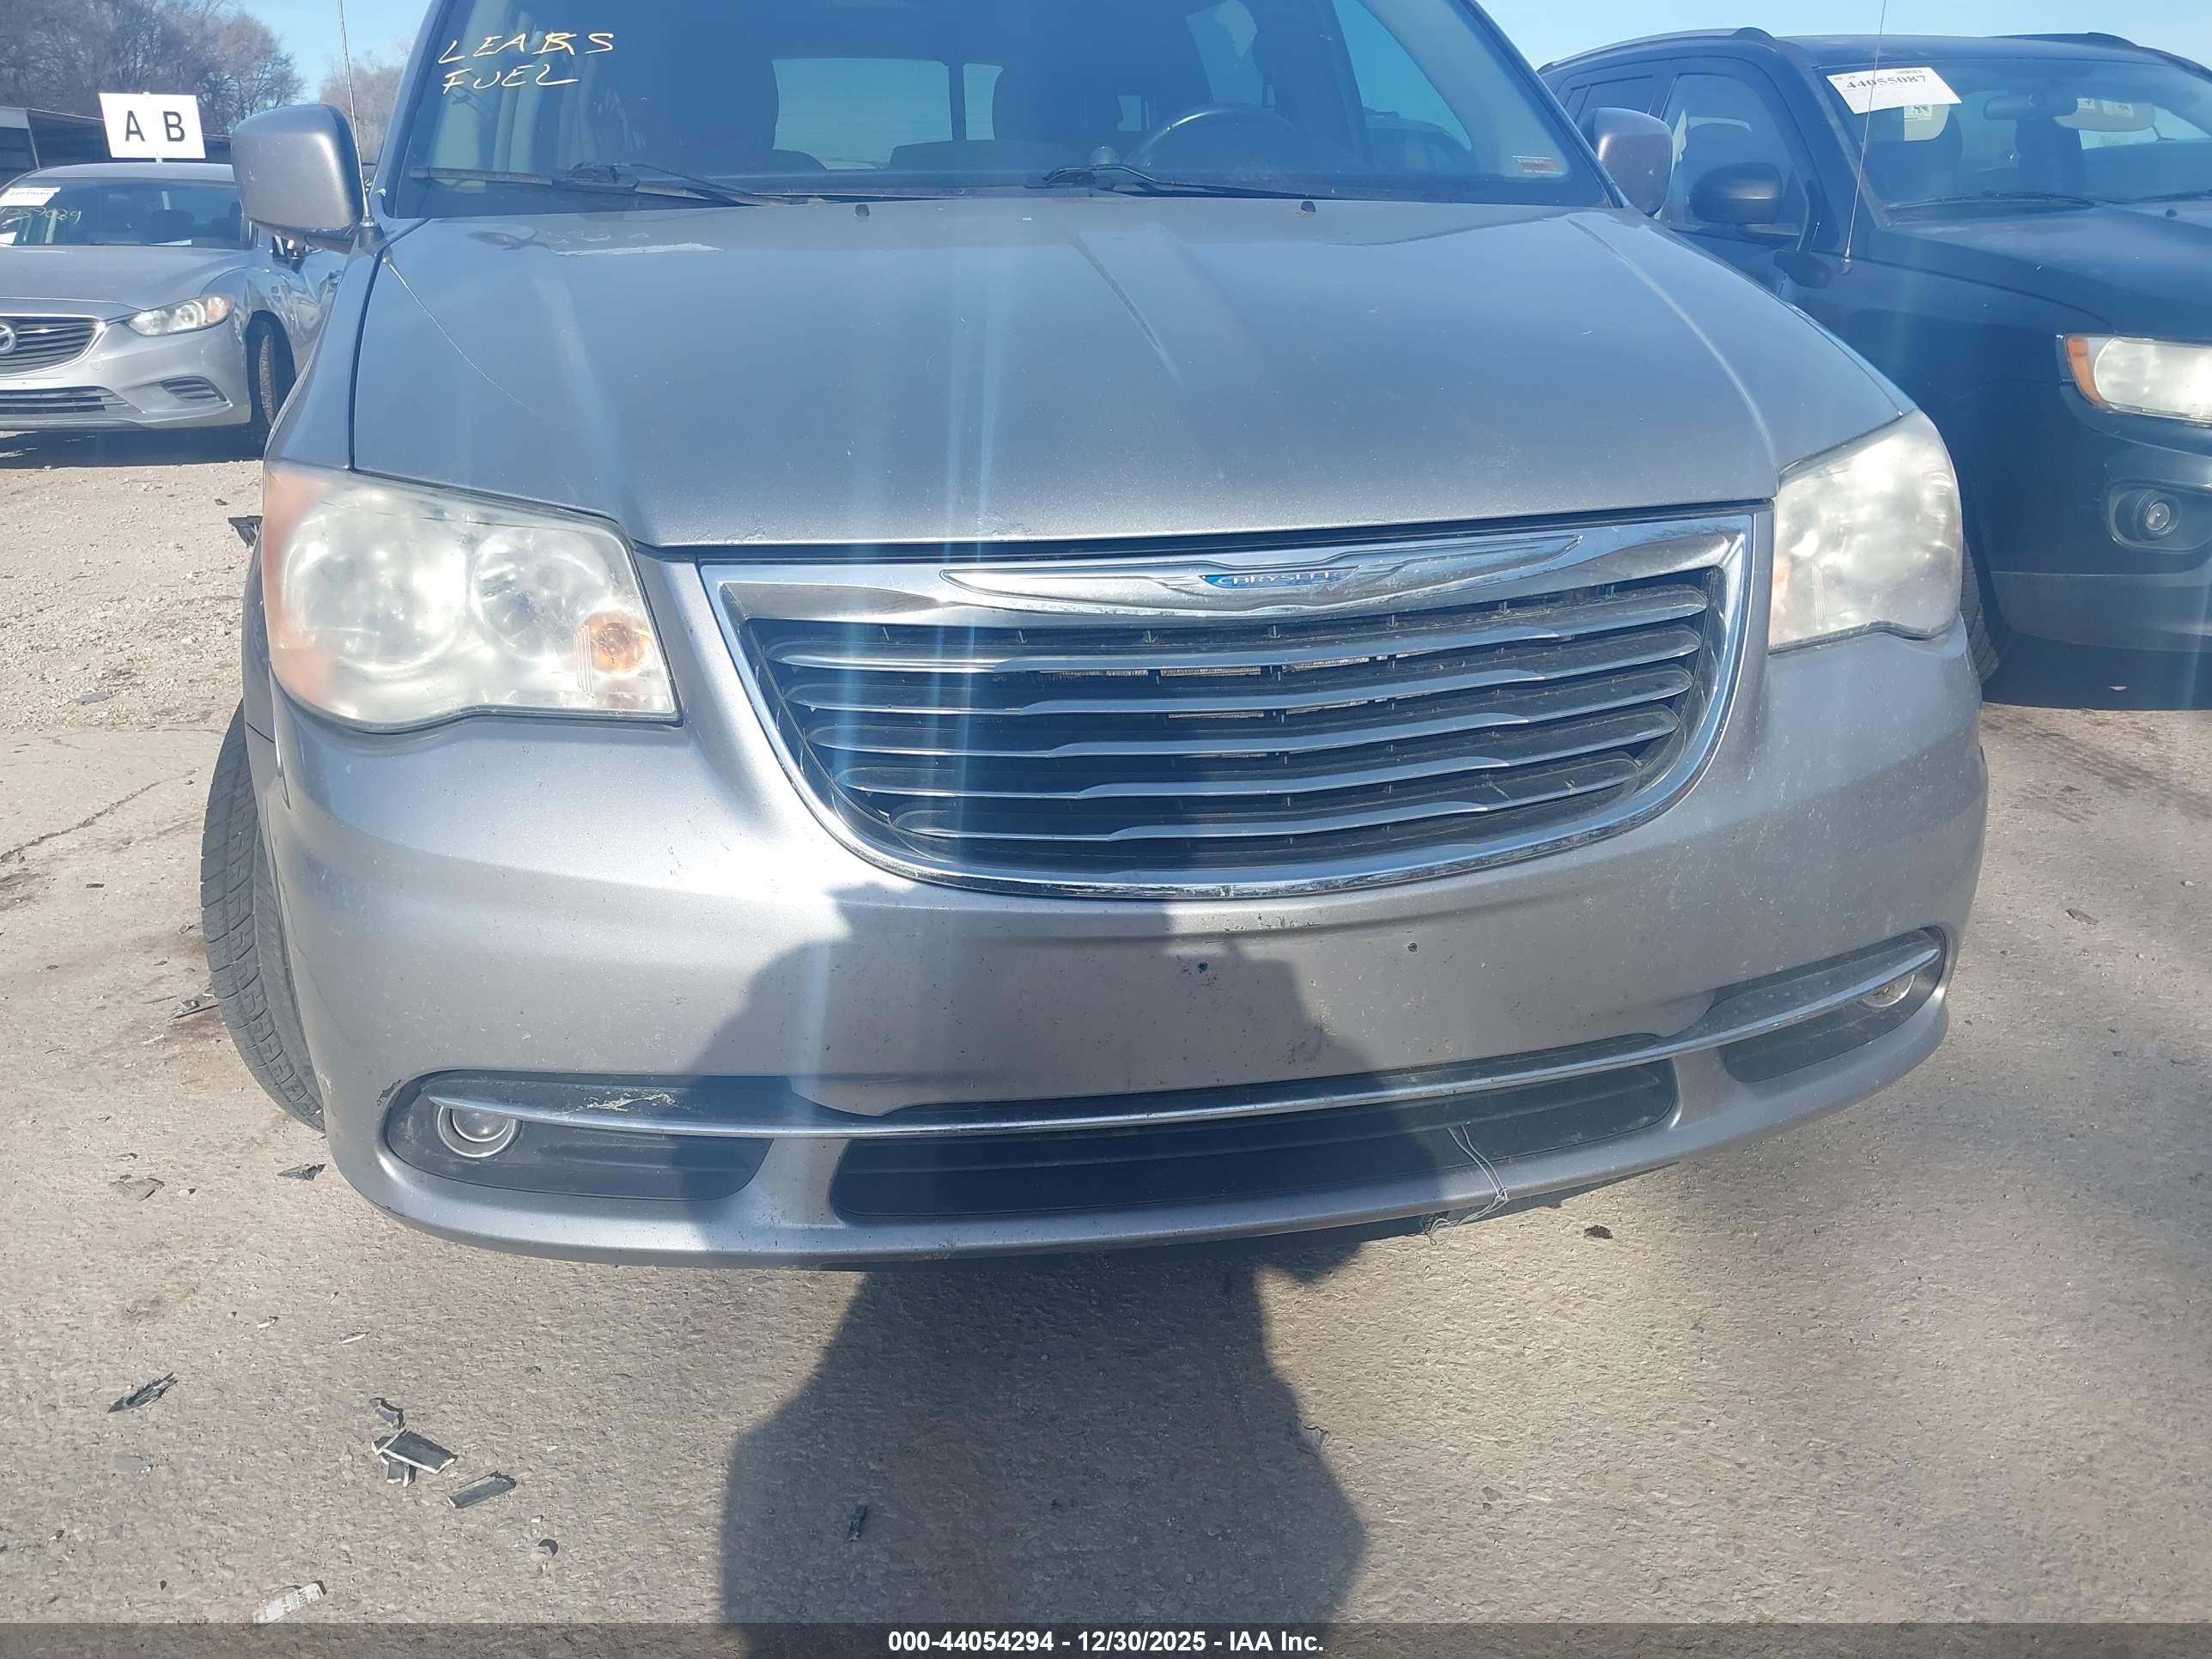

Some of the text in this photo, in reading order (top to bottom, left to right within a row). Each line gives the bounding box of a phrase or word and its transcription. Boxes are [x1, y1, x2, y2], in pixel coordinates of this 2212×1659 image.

[442, 64, 580, 95] FUEL
[1846, 75, 1927, 89] 44055087
[125, 110, 185, 143] A B
